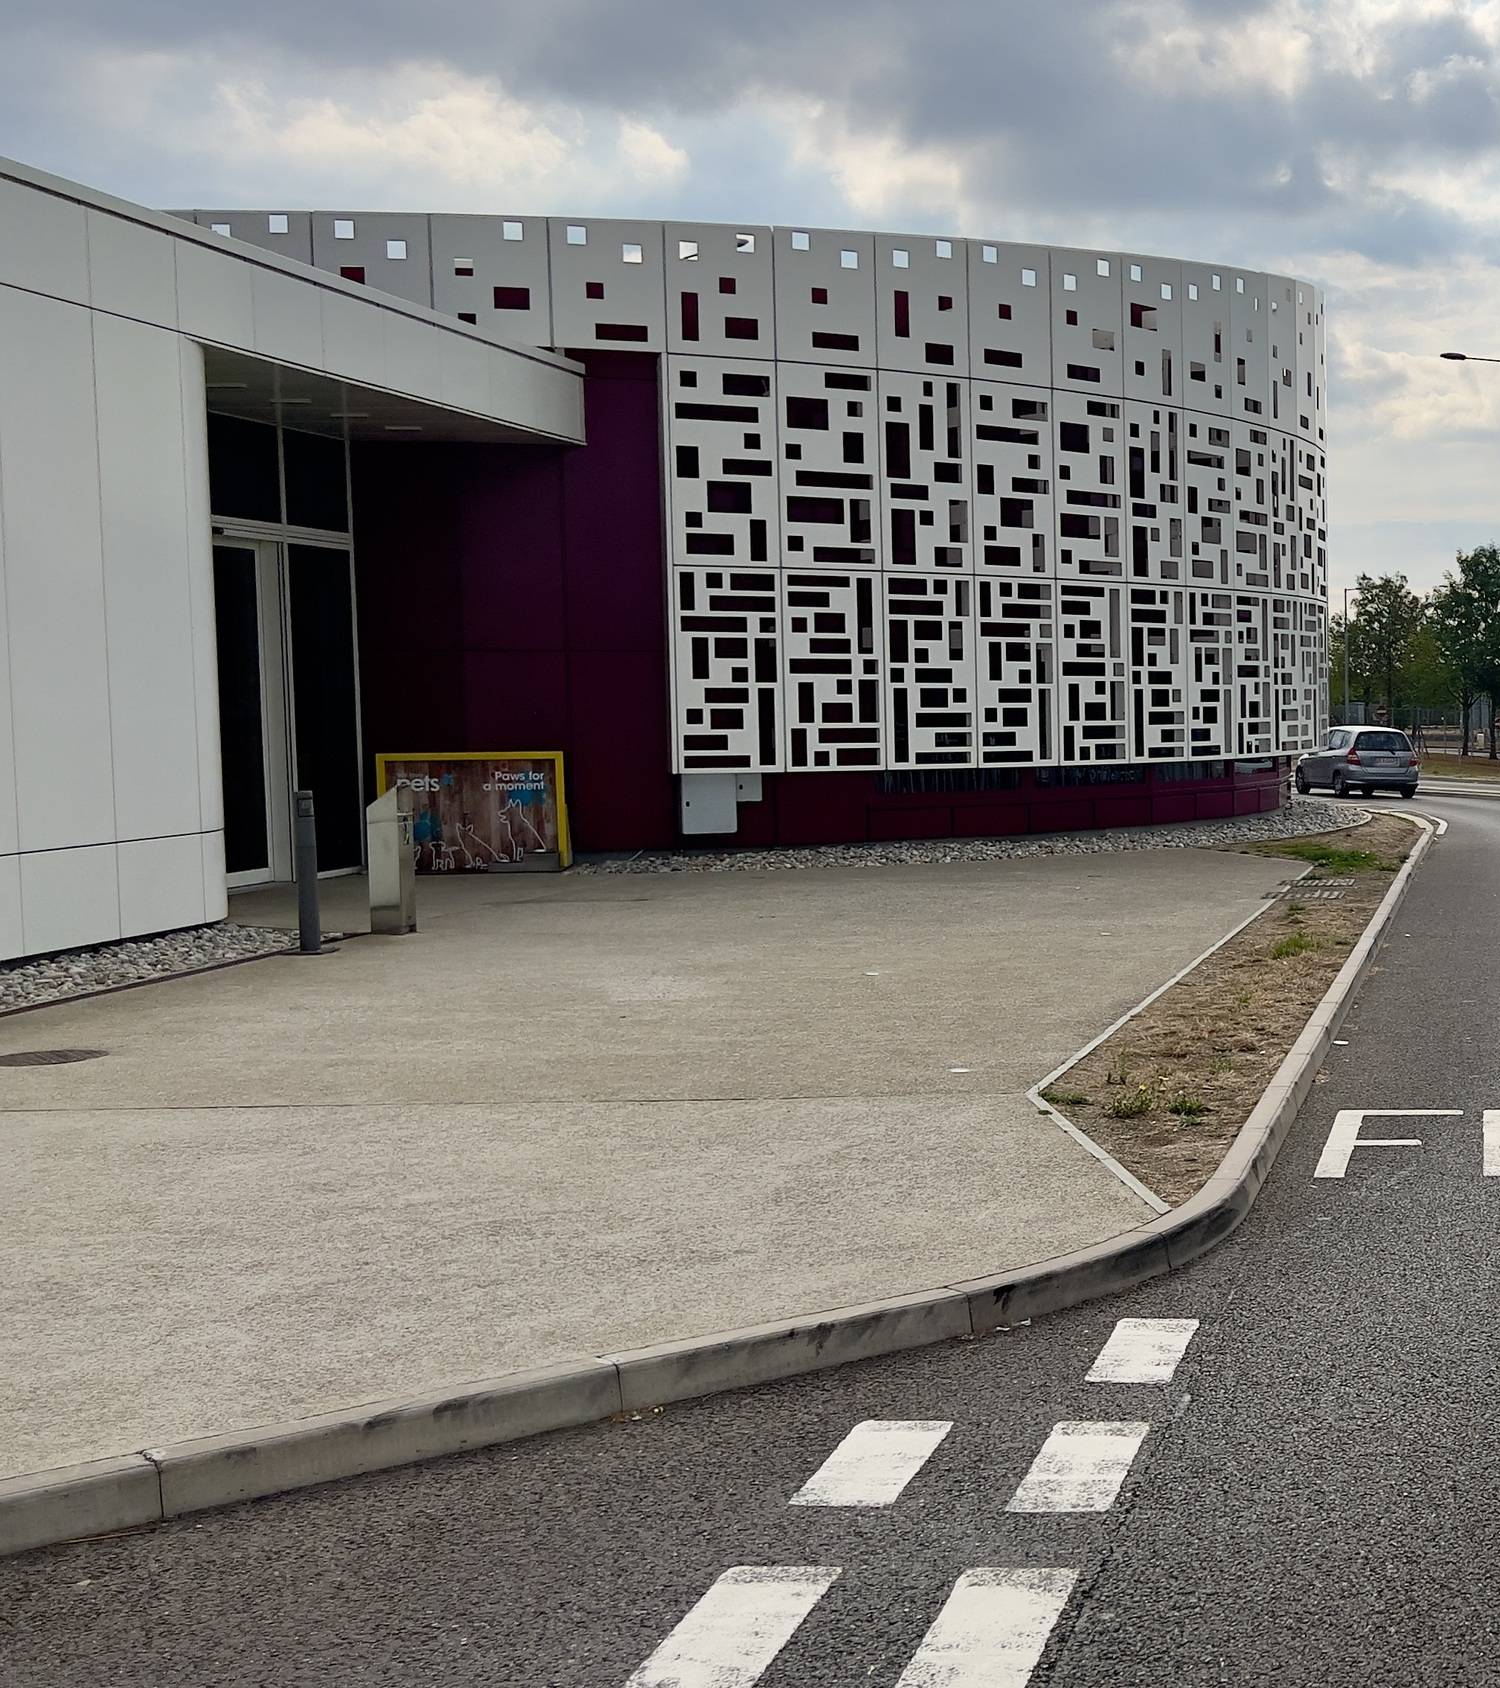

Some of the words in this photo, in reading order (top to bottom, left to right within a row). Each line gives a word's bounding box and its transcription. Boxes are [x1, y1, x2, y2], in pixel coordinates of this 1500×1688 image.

[494, 771, 526, 781] Paws
[529, 770, 545, 780] for
[396, 775, 440, 792] pets
[495, 781, 545, 791] moment
